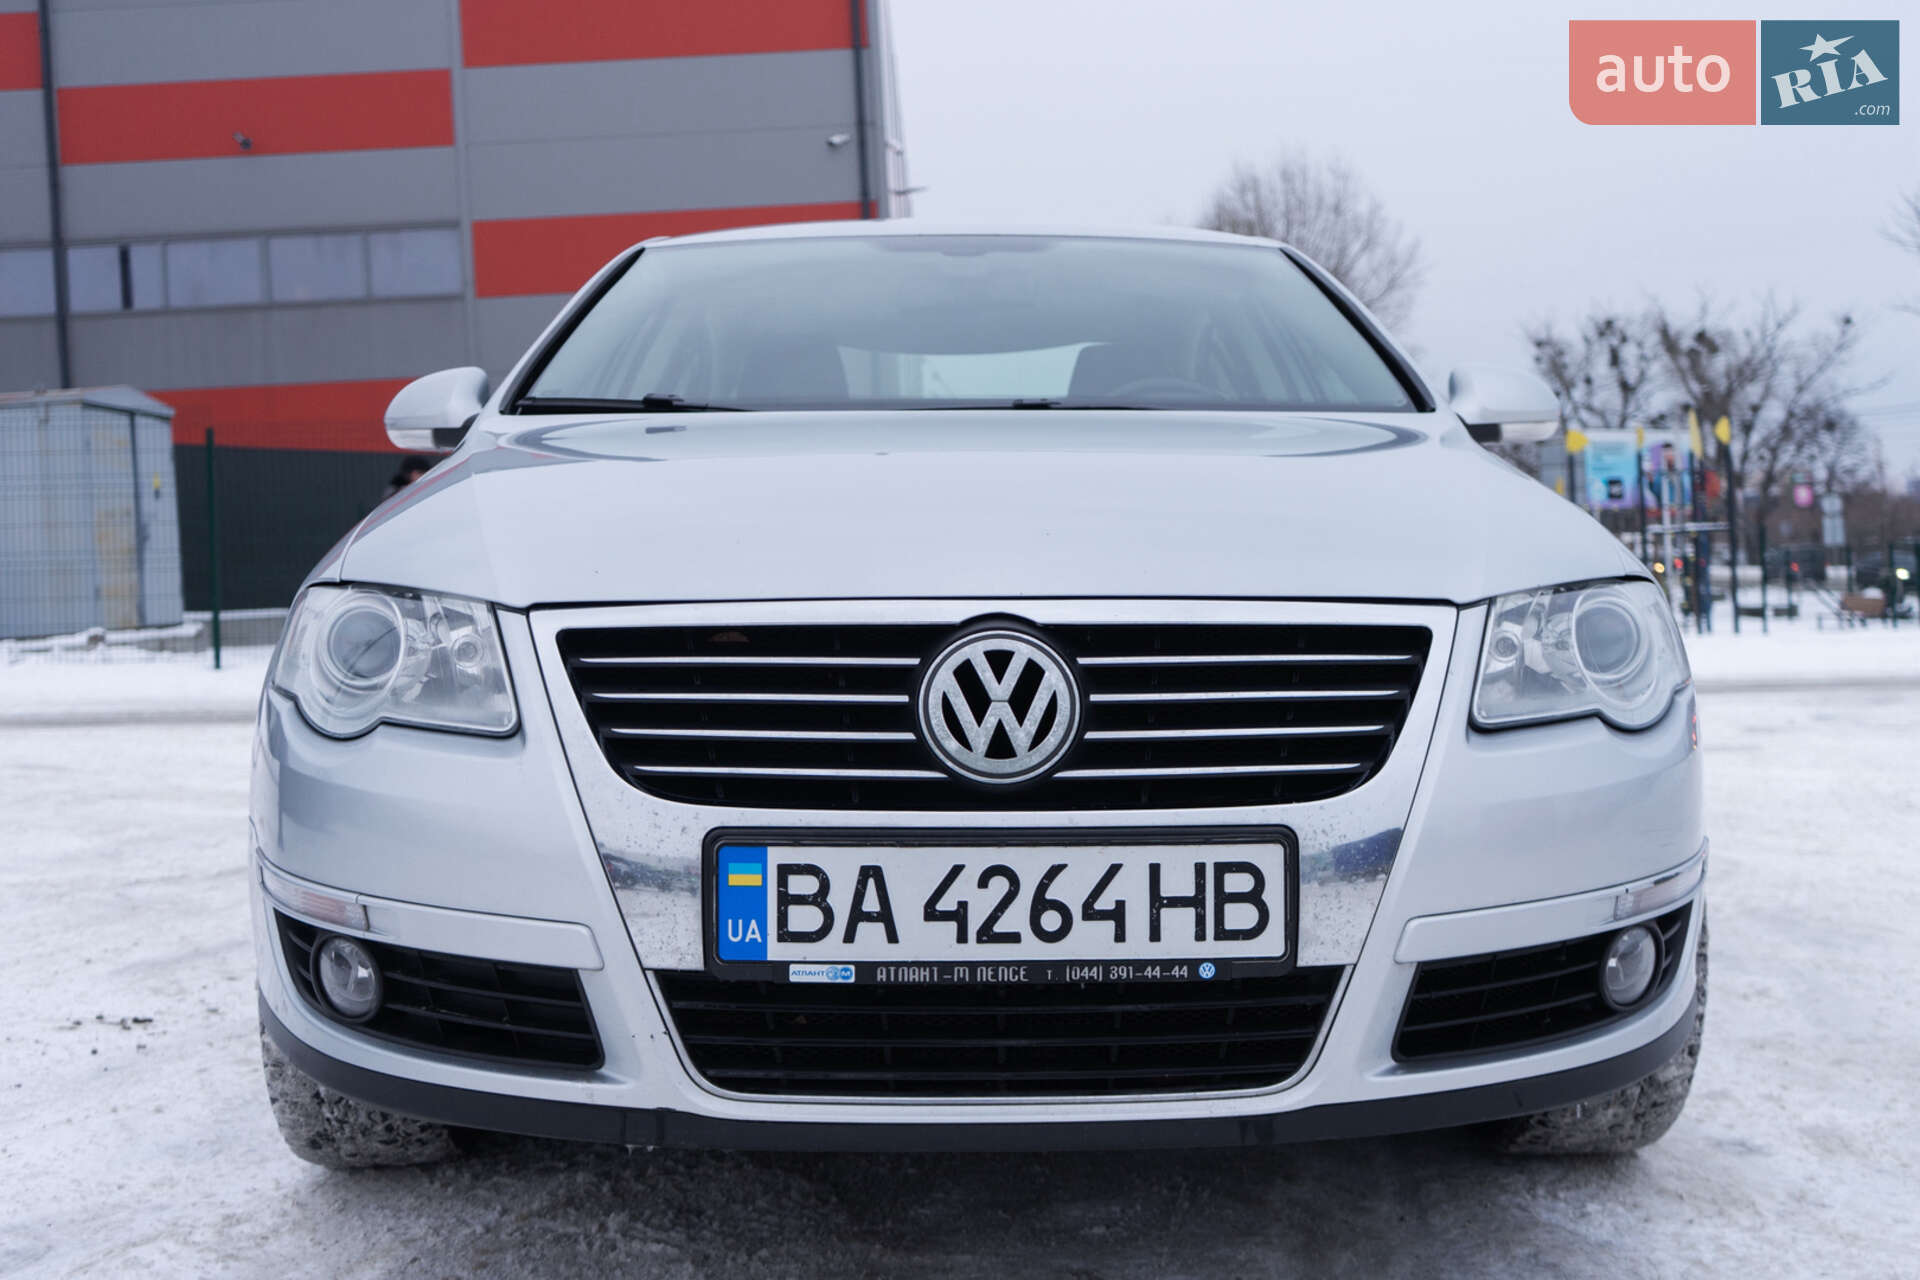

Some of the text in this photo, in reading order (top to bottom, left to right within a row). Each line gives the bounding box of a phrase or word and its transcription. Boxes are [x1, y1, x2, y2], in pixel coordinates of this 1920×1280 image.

[777, 861, 1270, 944] BA 4264 HB
[728, 919, 762, 943] UA
[1066, 965, 1103, 982] (044)
[1109, 965, 1188, 980] 391-44-44
